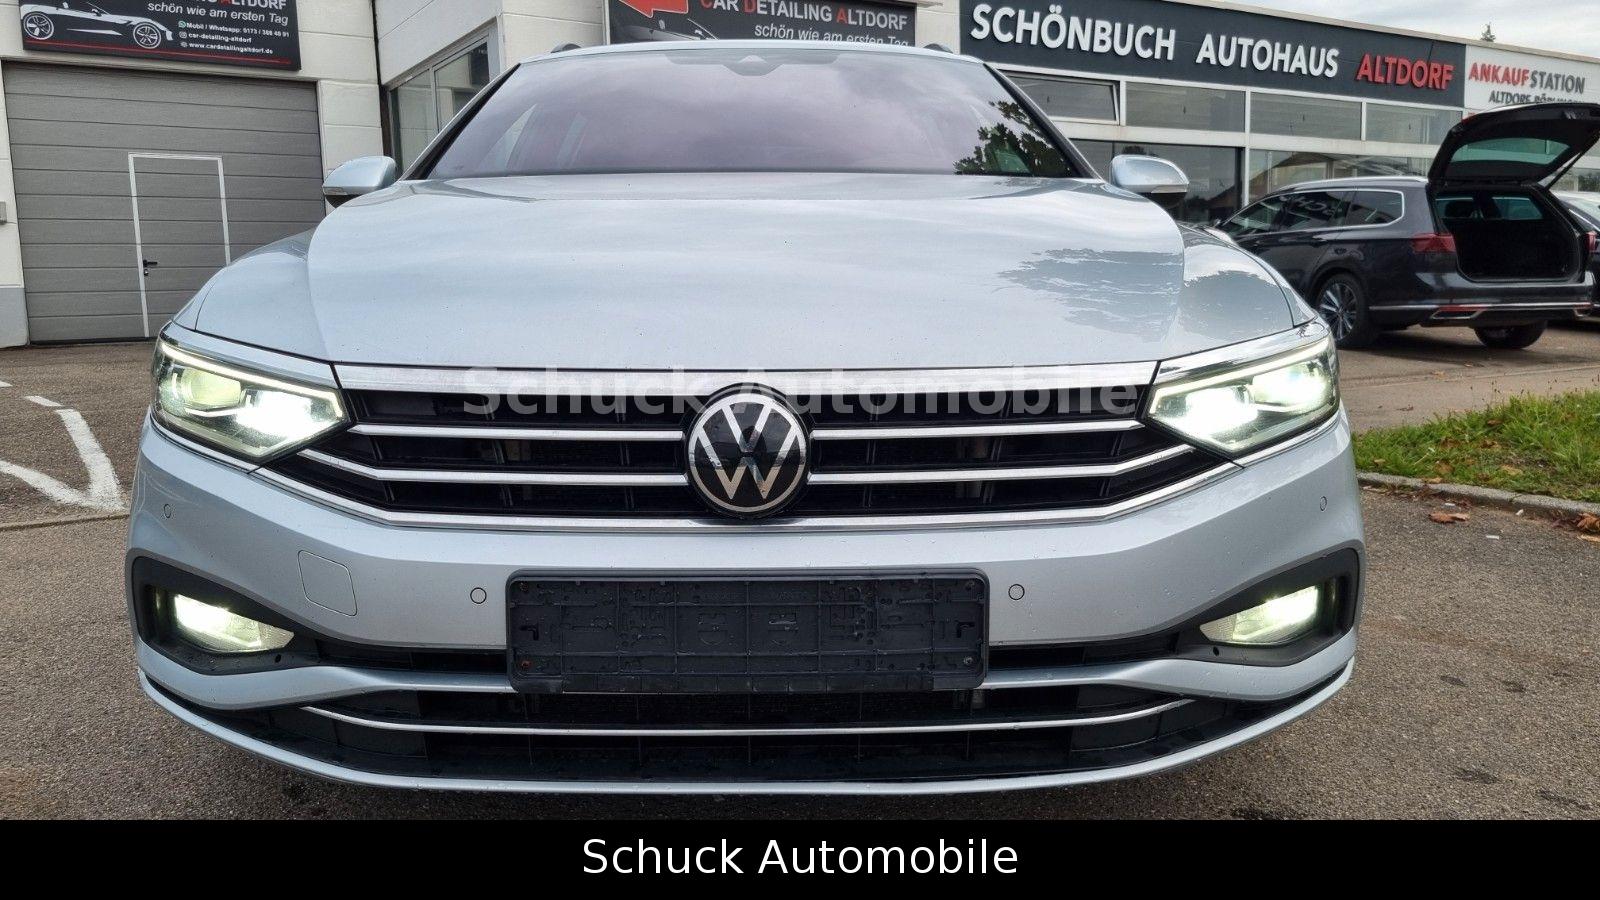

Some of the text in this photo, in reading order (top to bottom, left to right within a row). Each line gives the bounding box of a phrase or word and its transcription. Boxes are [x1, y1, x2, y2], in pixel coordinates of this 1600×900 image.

[147, 2, 289, 26] schön wie am ersten Tag
[744, 0, 832, 22] DETAILING
[836, 8, 908, 30] ALTDORF
[754, 23, 794, 40] schön
[798, 27, 820, 41] wie
[823, 32, 843, 42] am
[970, 3, 1454, 90] SCHÖNBUCH AUTOHAUS ALTDORF
